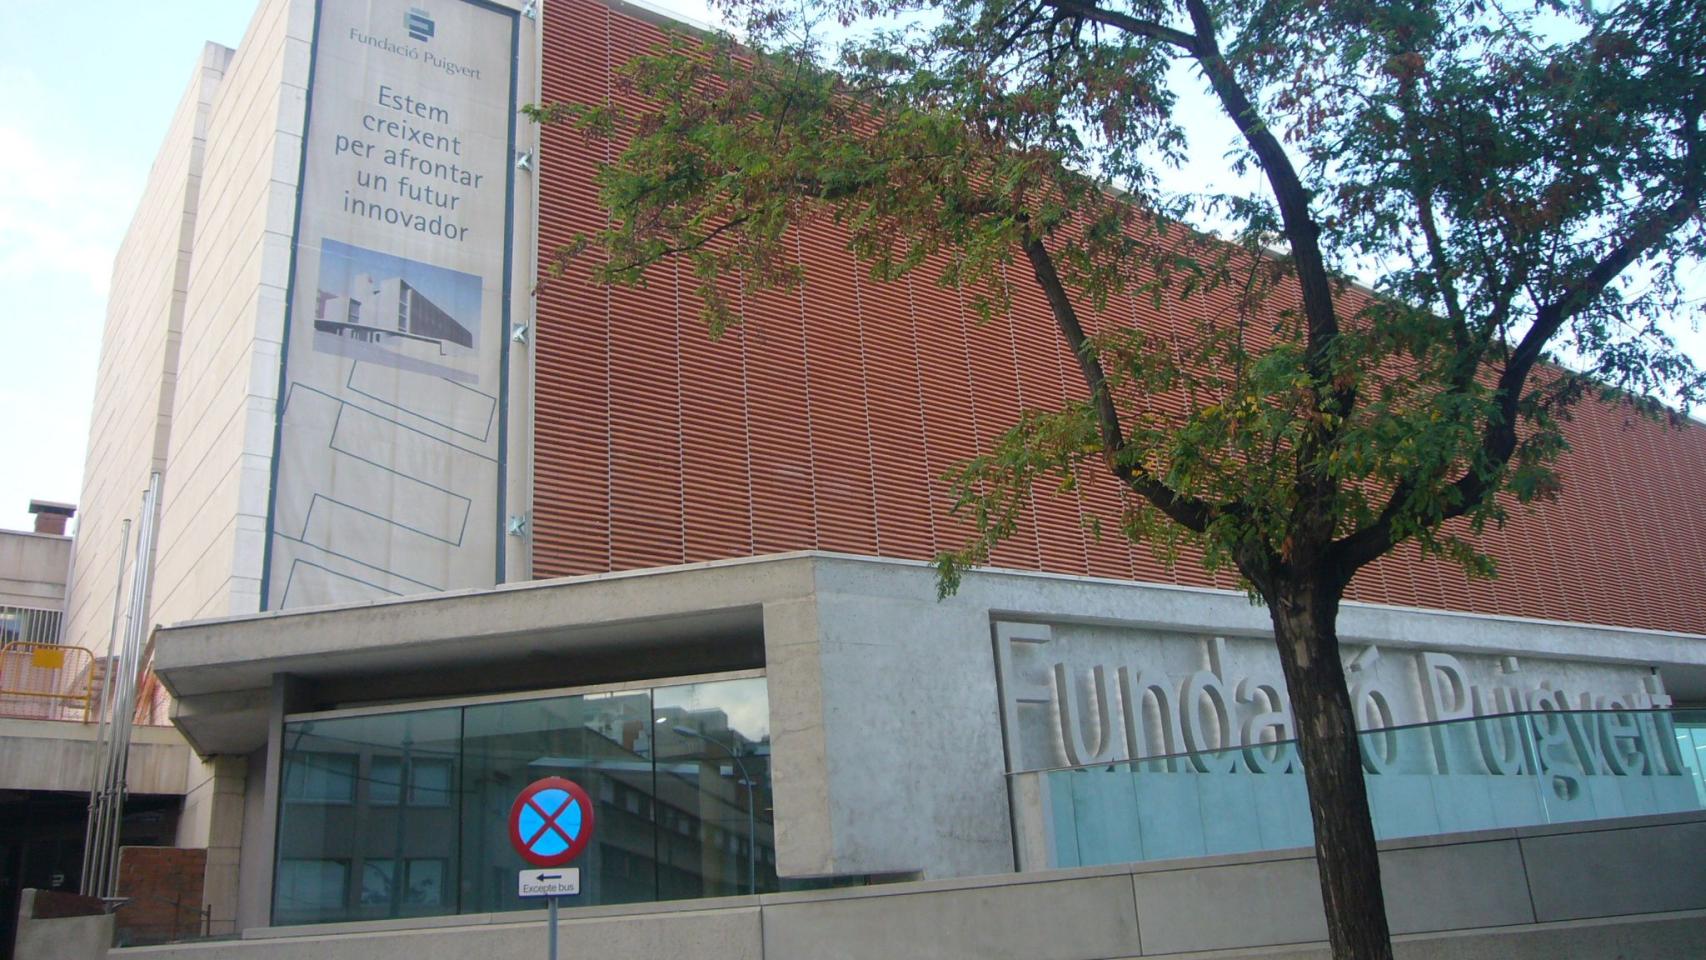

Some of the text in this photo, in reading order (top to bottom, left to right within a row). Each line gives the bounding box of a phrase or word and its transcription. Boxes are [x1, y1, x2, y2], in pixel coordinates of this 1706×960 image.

[349, 28, 482, 80] Fundació Puigvert
[378, 85, 449, 125] Estem
[362, 113, 461, 156] creixent
[335, 134, 483, 189] per afrontar
[357, 170, 460, 211] un futur
[344, 190, 469, 242] innovador
[994, 620, 1690, 805] Fundaó Puigvert
[523, 883, 574, 894] Excepte bus
